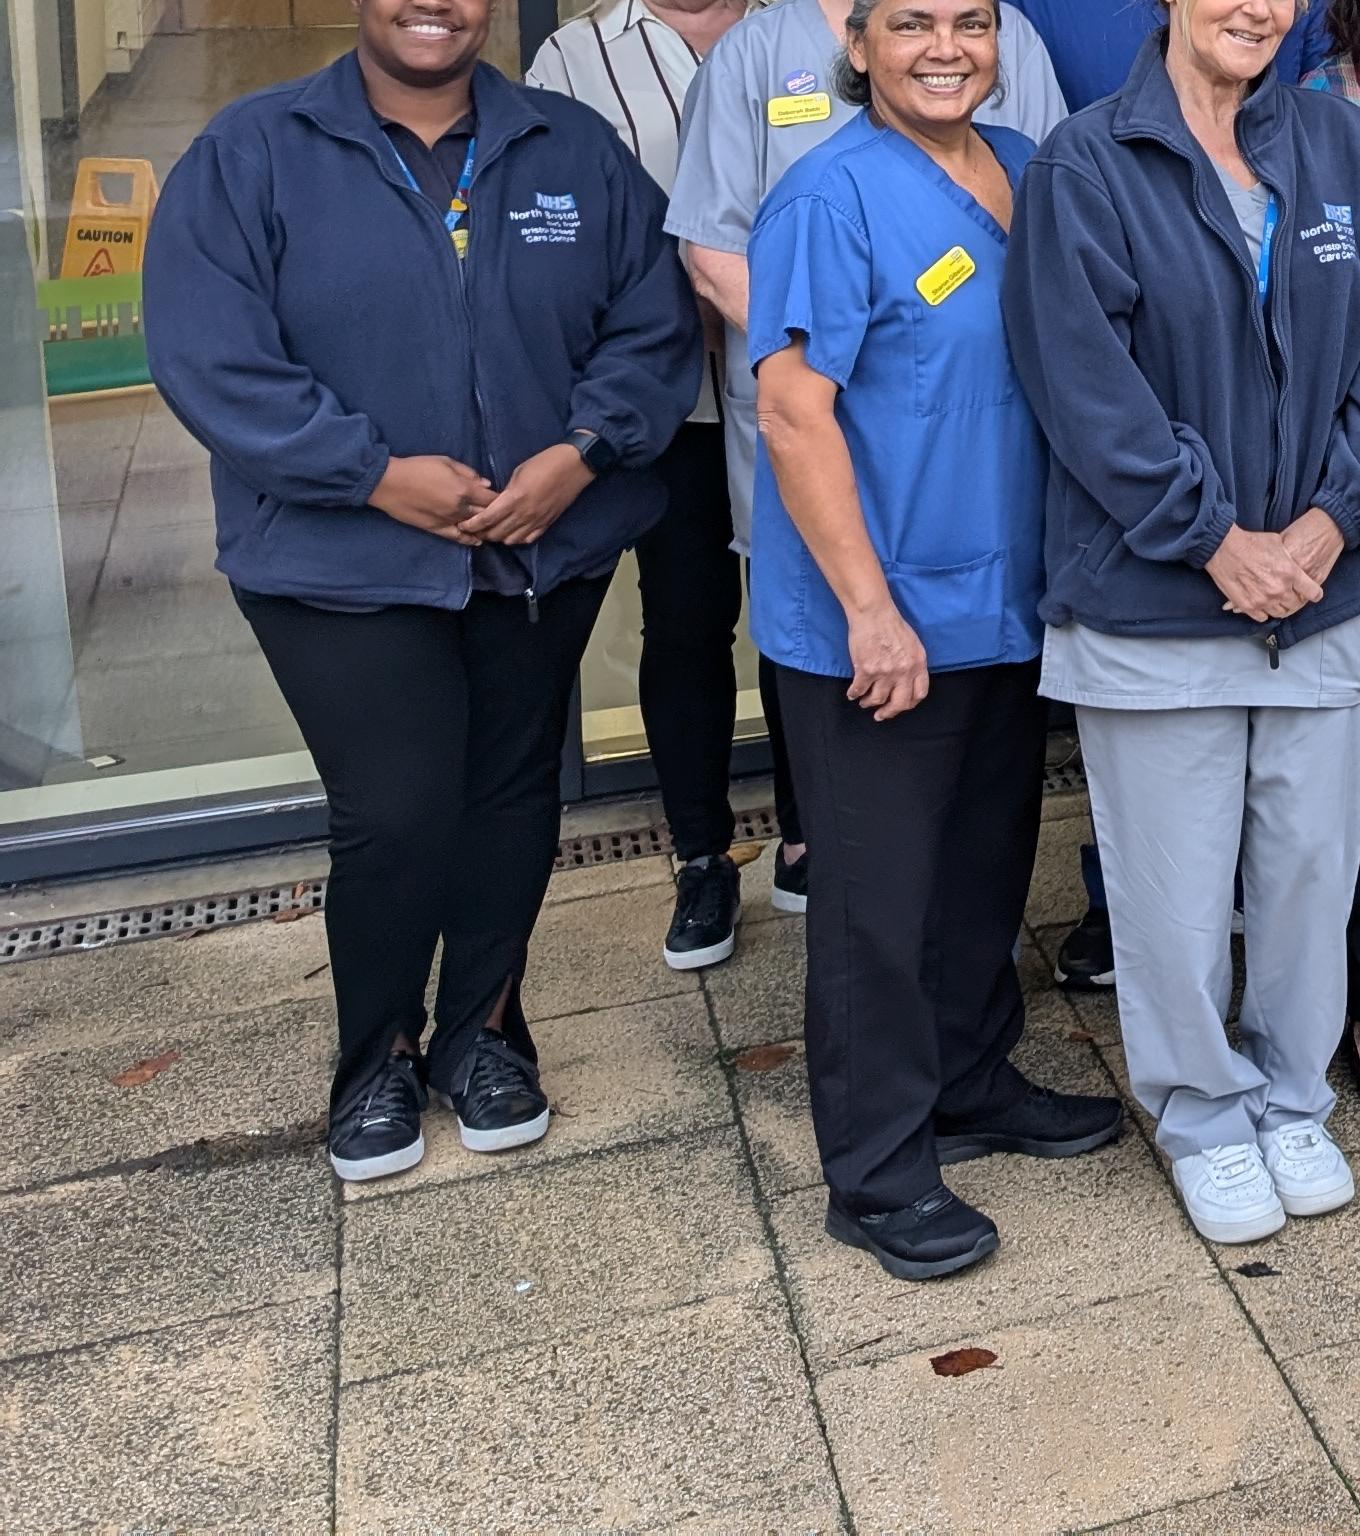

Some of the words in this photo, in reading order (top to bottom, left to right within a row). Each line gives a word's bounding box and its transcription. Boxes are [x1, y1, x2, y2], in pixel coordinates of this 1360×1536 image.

[537, 193, 576, 210] NHS
[510, 209, 542, 221] North
[77, 228, 134, 244] CAUTION
[1300, 221, 1334, 241] North
[526, 235, 548, 243] Care
[1319, 252, 1341, 263] Care
